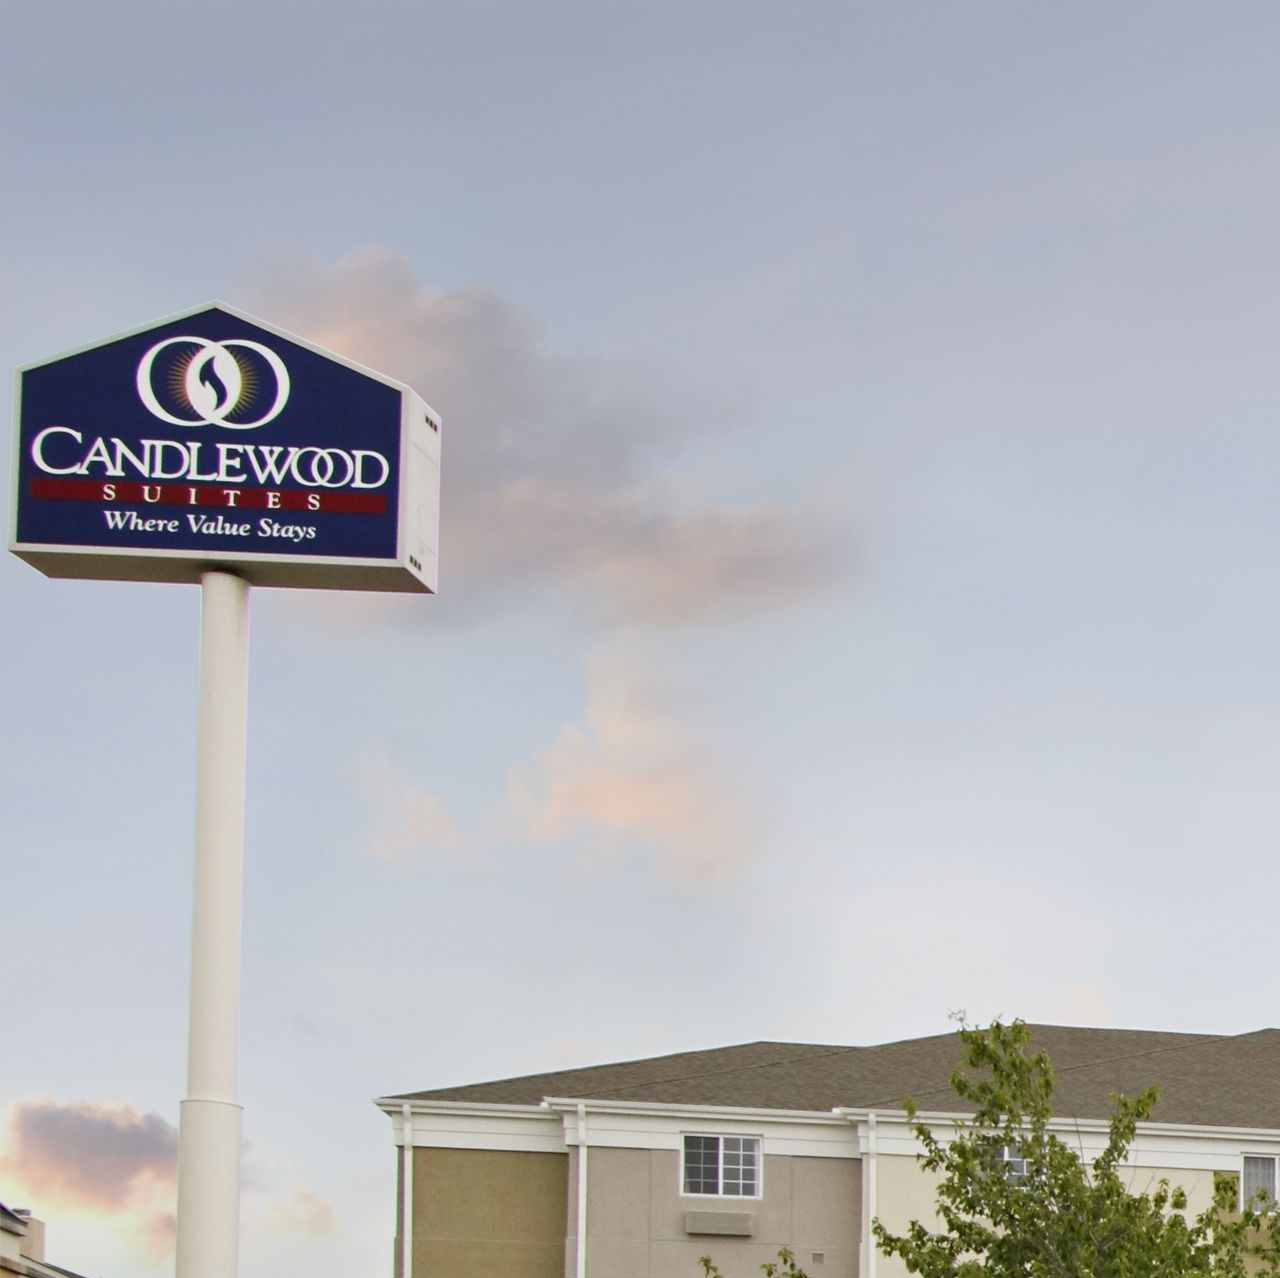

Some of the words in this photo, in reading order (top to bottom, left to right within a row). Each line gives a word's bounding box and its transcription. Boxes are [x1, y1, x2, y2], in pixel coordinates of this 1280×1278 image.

[31, 427, 390, 488] CANDLEWOOD
[103, 484, 320, 511] SUITES
[103, 510, 179, 532] Where
[188, 515, 252, 537] Value
[258, 519, 317, 542] Stays
